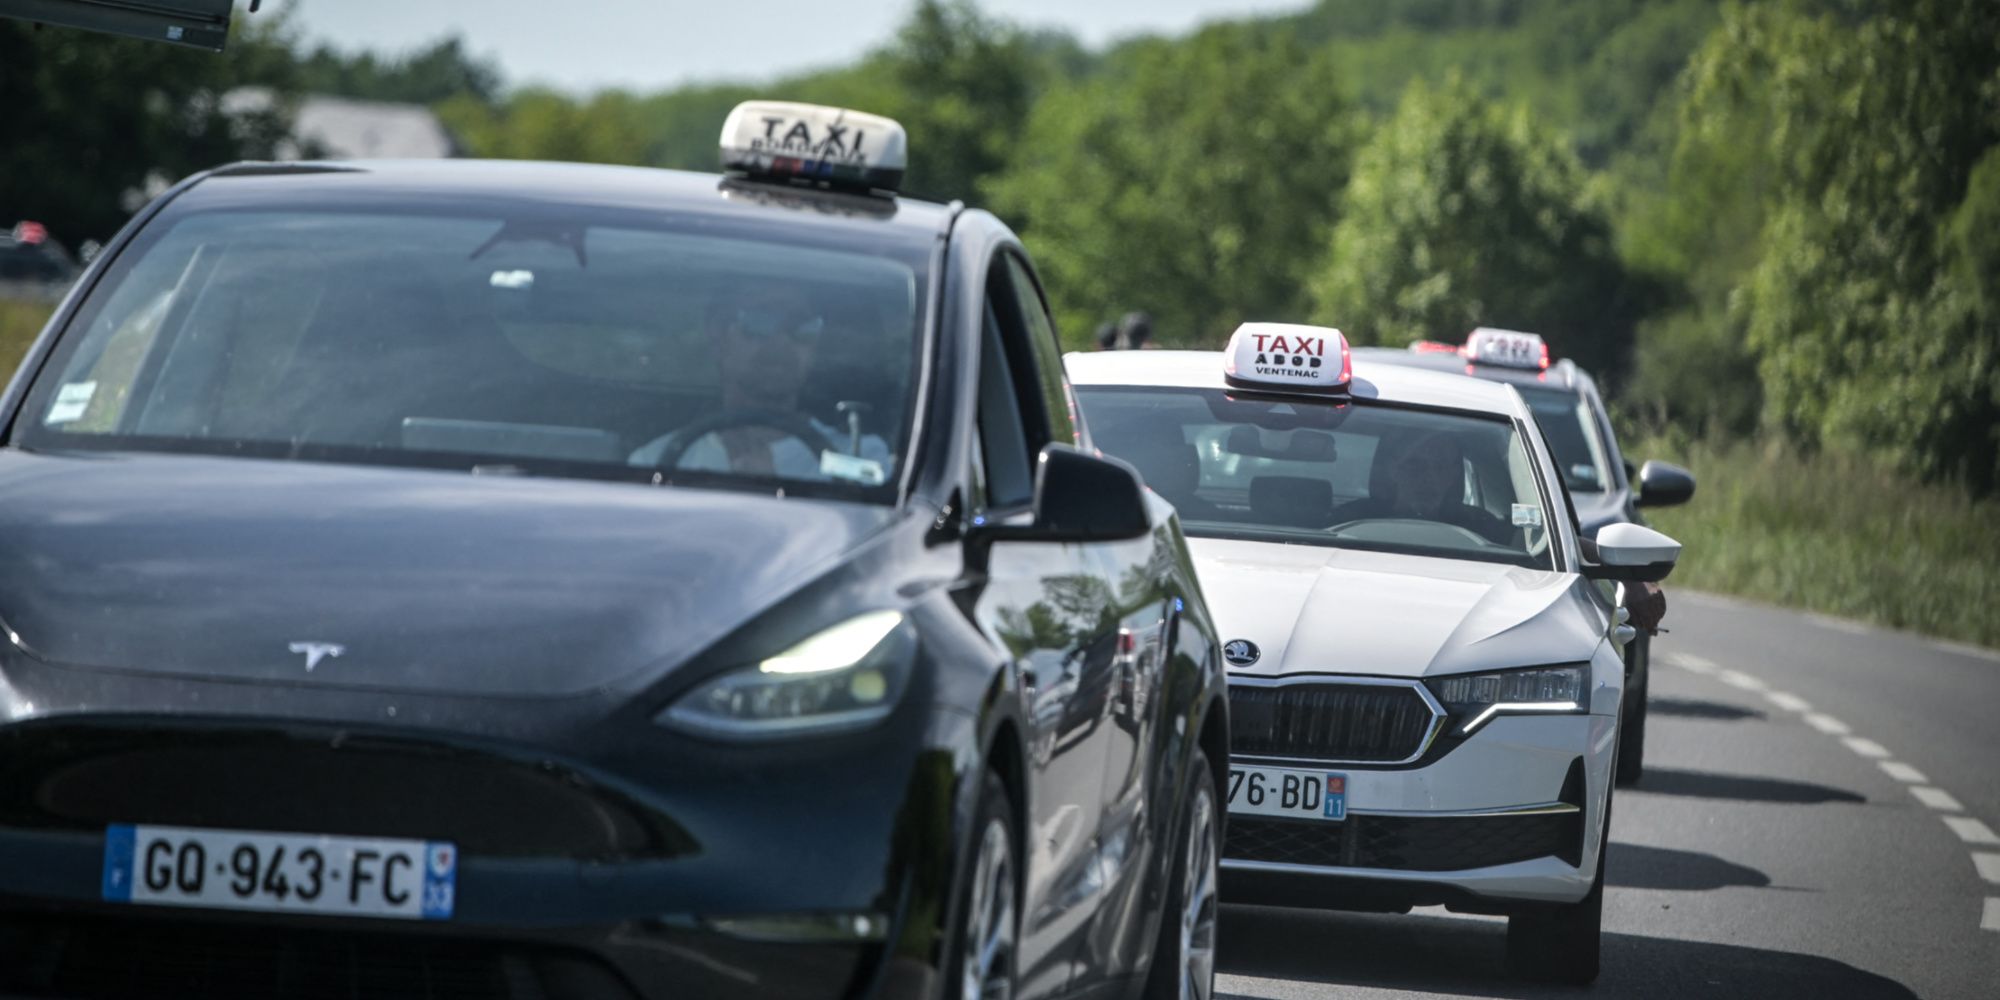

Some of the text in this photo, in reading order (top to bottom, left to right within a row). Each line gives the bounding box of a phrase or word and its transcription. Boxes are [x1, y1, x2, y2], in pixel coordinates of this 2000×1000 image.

[761, 116, 864, 152] TAXI
[1251, 334, 1324, 357] TAXI
[1256, 366, 1319, 378] VENTENAC
[1228, 770, 1321, 811] 76-BD
[1328, 799, 1342, 815] 11
